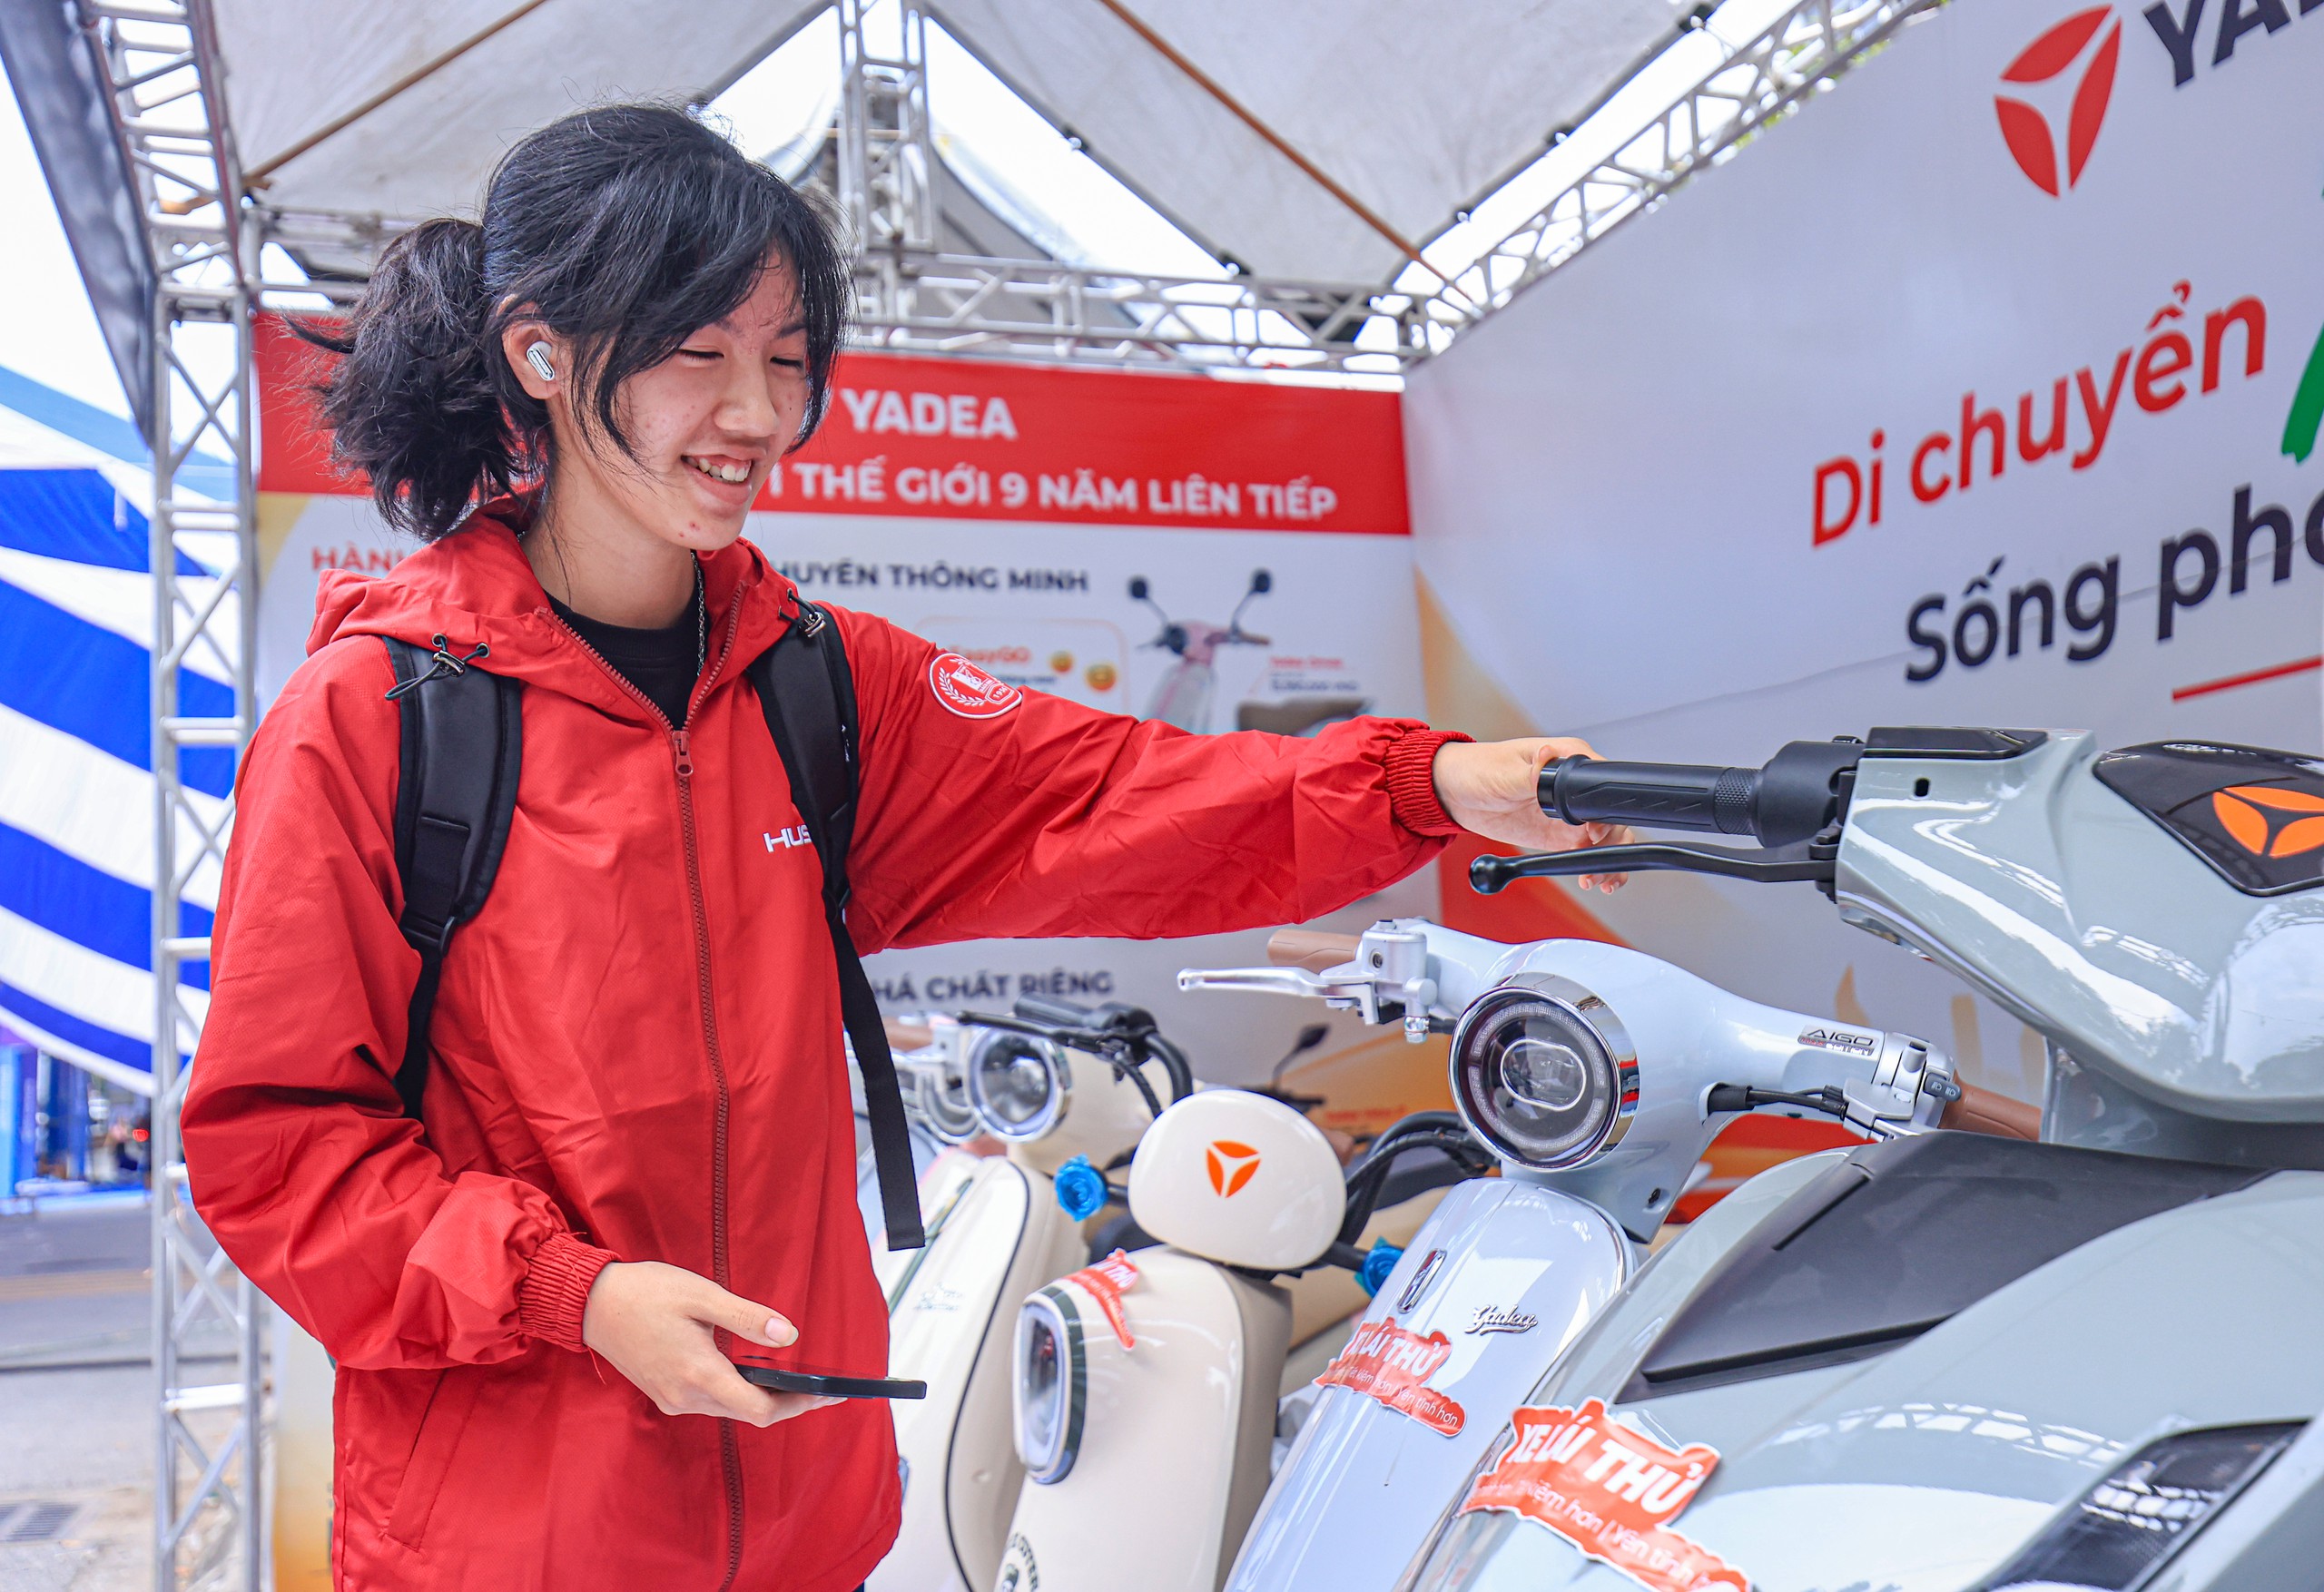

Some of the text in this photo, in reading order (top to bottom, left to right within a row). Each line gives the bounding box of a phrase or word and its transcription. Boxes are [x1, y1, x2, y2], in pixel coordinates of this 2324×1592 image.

[2142, 0, 2324, 88] YA
[841, 388, 1019, 440] YADEA
[1812, 428, 1885, 548] Di
[1910, 279, 2266, 505] chuyển
[793, 455, 887, 500] THẾ
[895, 462, 990, 505] GIỚI
[1000, 471, 1029, 508] 9
[1038, 467, 1138, 512] NĂM
[1147, 473, 1240, 516] LIÊN
[1246, 476, 1337, 520] TIẾP
[312, 541, 403, 571] HÀN
[889, 561, 998, 589] THÔNG
[1008, 569, 1088, 591] MINH
[1906, 555, 2120, 683] Sống
[872, 967, 1113, 999] HÁ CHẤT RIÊNG
[1807, 1028, 1874, 1046] AIGO
[1383, 1337, 1443, 1377] THỬ
[1399, 1387, 1415, 1403] Yên
[1437, 1405, 1458, 1428] hơn
[1506, 1423, 1551, 1463] XE
[1583, 1439, 1705, 1515] THỬ
